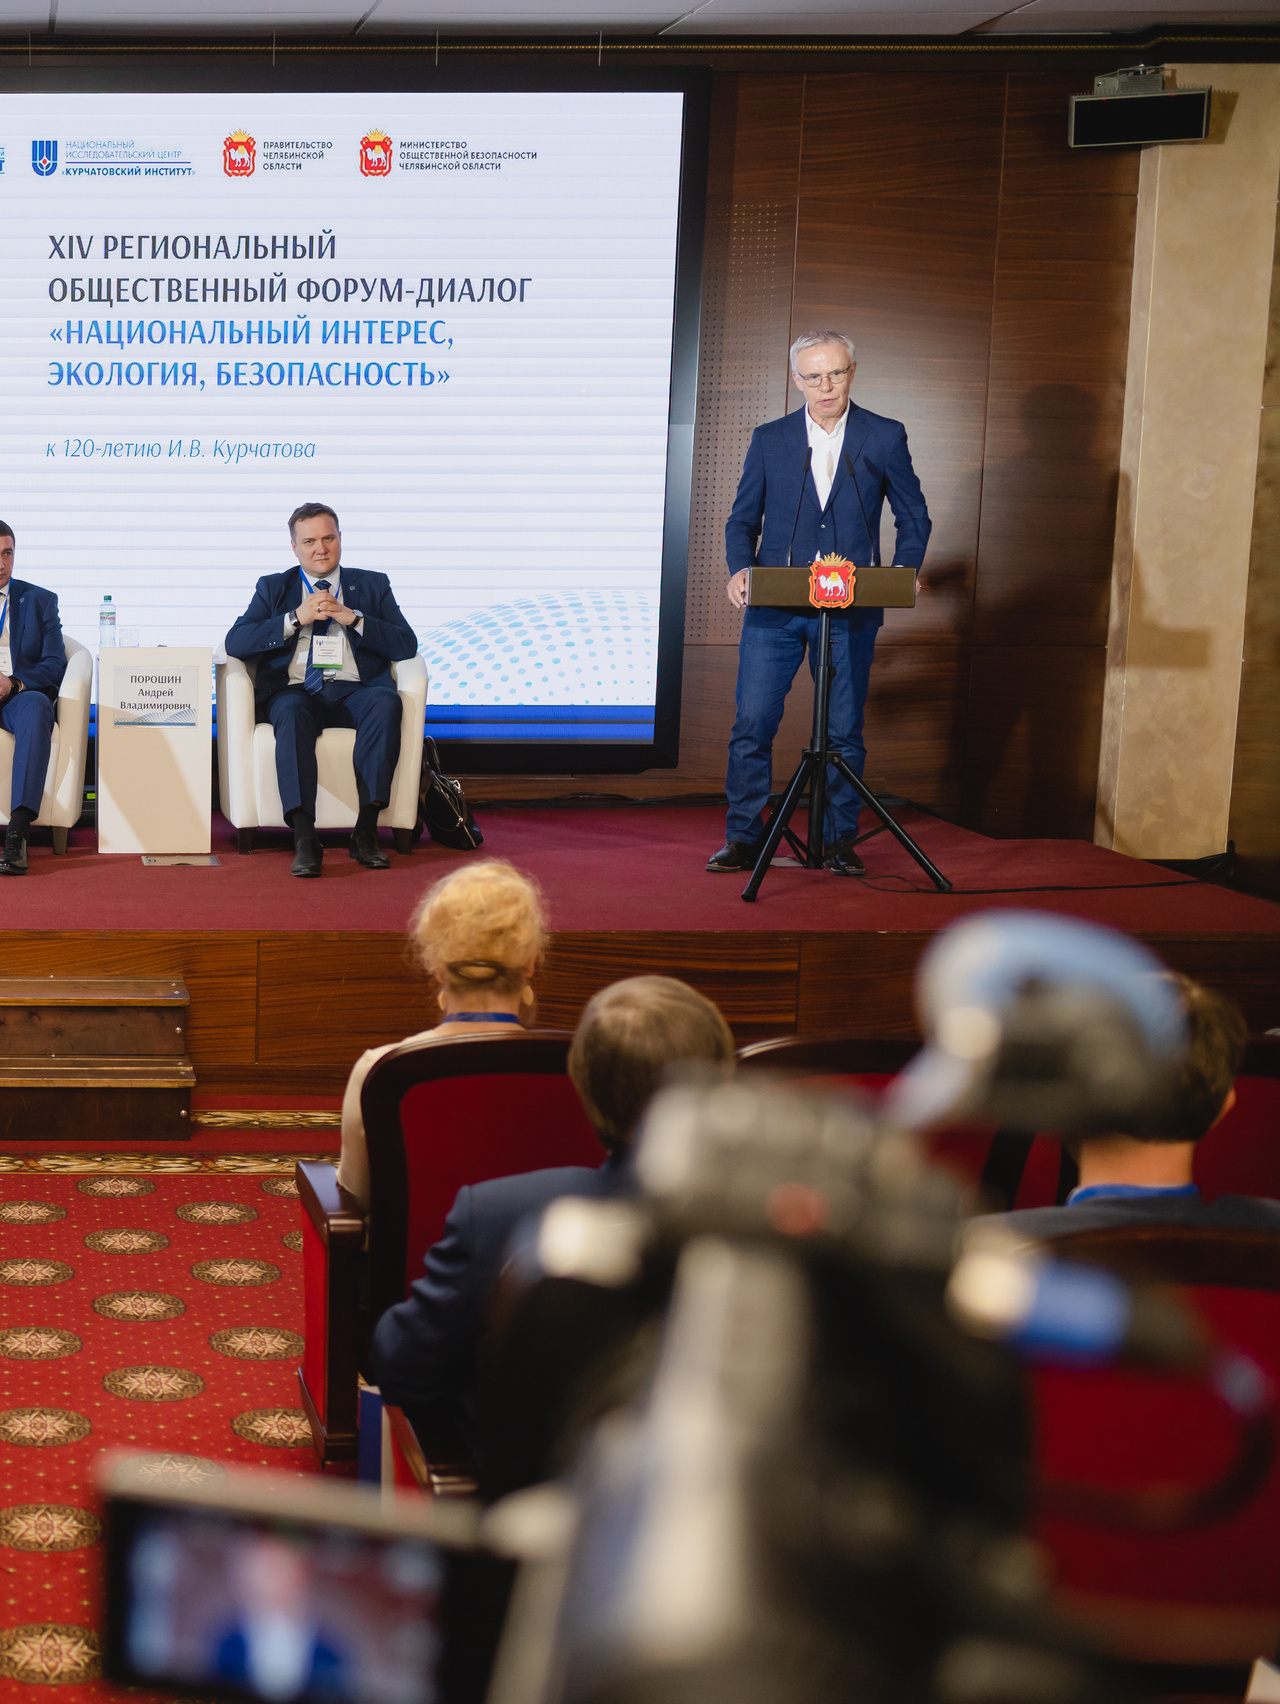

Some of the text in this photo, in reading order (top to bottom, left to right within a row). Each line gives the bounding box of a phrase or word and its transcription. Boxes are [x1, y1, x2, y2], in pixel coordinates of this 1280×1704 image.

[65, 140, 135, 149] НАЦИОНАЛЬНЫЙ
[263, 141, 333, 149] ПРАВИТЕЛЬСТВО
[399, 141, 468, 149] МИНИСТЕРСТВО
[65, 150, 182, 160] ИССЛЕДОВАТЕЛЬСКИЙ ЦЕНТР
[263, 151, 325, 160] ЧЕЛЯБИНСКОЙ
[399, 151, 538, 161] ОБЩЕСТВЕННОЙ БЕЗОПАСНОСТИ
[263, 162, 302, 170] ОБЛАСТИ
[399, 161, 501, 170] ЧЕЛЯБИНСКОЙ ОБЛАСТИ
[61, 166, 196, 176] «КУРЧАТОВСКИЙ ИНСТИТУТ»
[48, 229, 337, 260] XIV РЕГИОНАЛЬНЫЙ
[48, 272, 533, 308] ОБЩЕСТВЕННЫЙ ФОРУМ-ДИАЛОГ
[50, 314, 454, 349] «НАЦИОНАЛЬНЫЙ ИНТЕРЕС,
[47, 362, 451, 391] ЭКОЛОГИЯ, БЕЗОПАСНОСТЬ»
[46, 438, 316, 464] к 120-летию И.В. Курчатова
[130, 675, 182, 684] ПОРОШИН
[137, 688, 174, 700] Андрей
[120, 701, 191, 713] Владимирович
